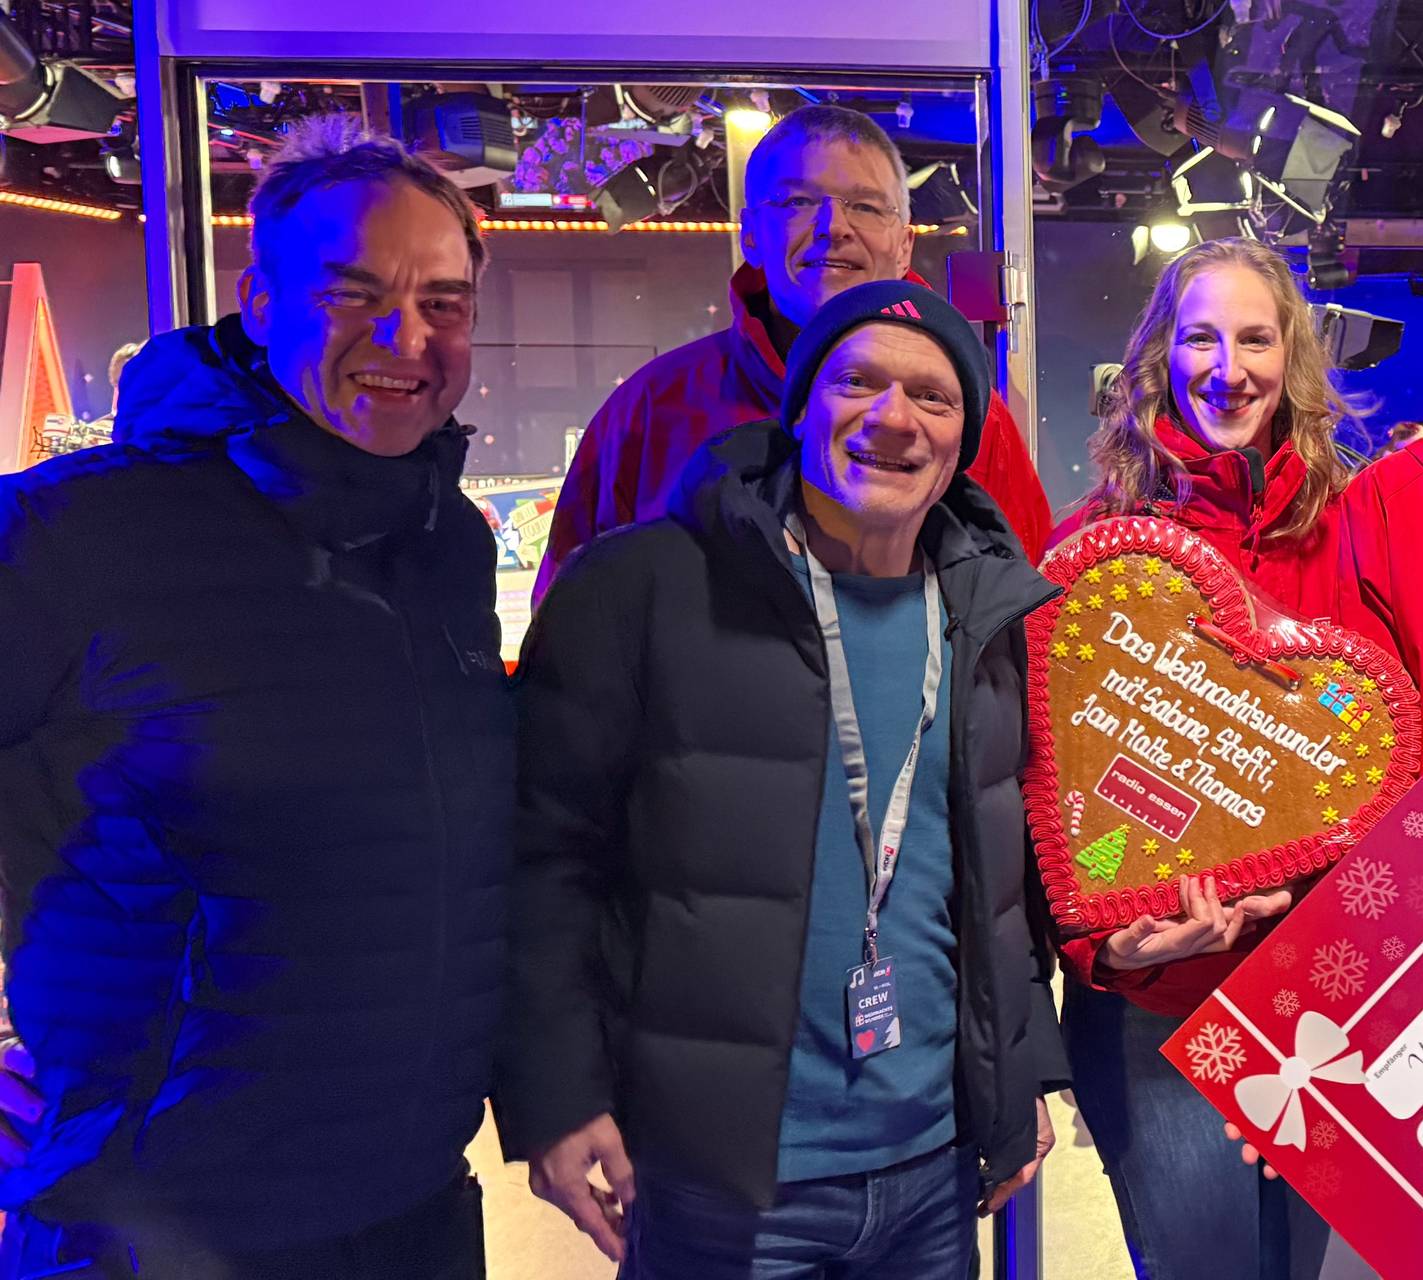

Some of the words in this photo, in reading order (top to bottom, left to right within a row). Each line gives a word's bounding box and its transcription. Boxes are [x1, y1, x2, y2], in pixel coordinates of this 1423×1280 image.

[1101, 668, 1149, 706] mit
[1140, 686, 1210, 757] Sabine,
[1210, 726, 1278, 794] Steffi,
[1102, 611, 1156, 664] Das
[1153, 640, 1347, 776] Weihnachtswunder
[1071, 693, 1120, 738] Jan
[1171, 758, 1193, 781] &
[1188, 758, 1266, 828] Thomas
[1111, 769, 1146, 795] radio
[1147, 792, 1187, 821] essen
[858, 991, 889, 1009] CREW
[1373, 1043, 1409, 1079] Empfänger
